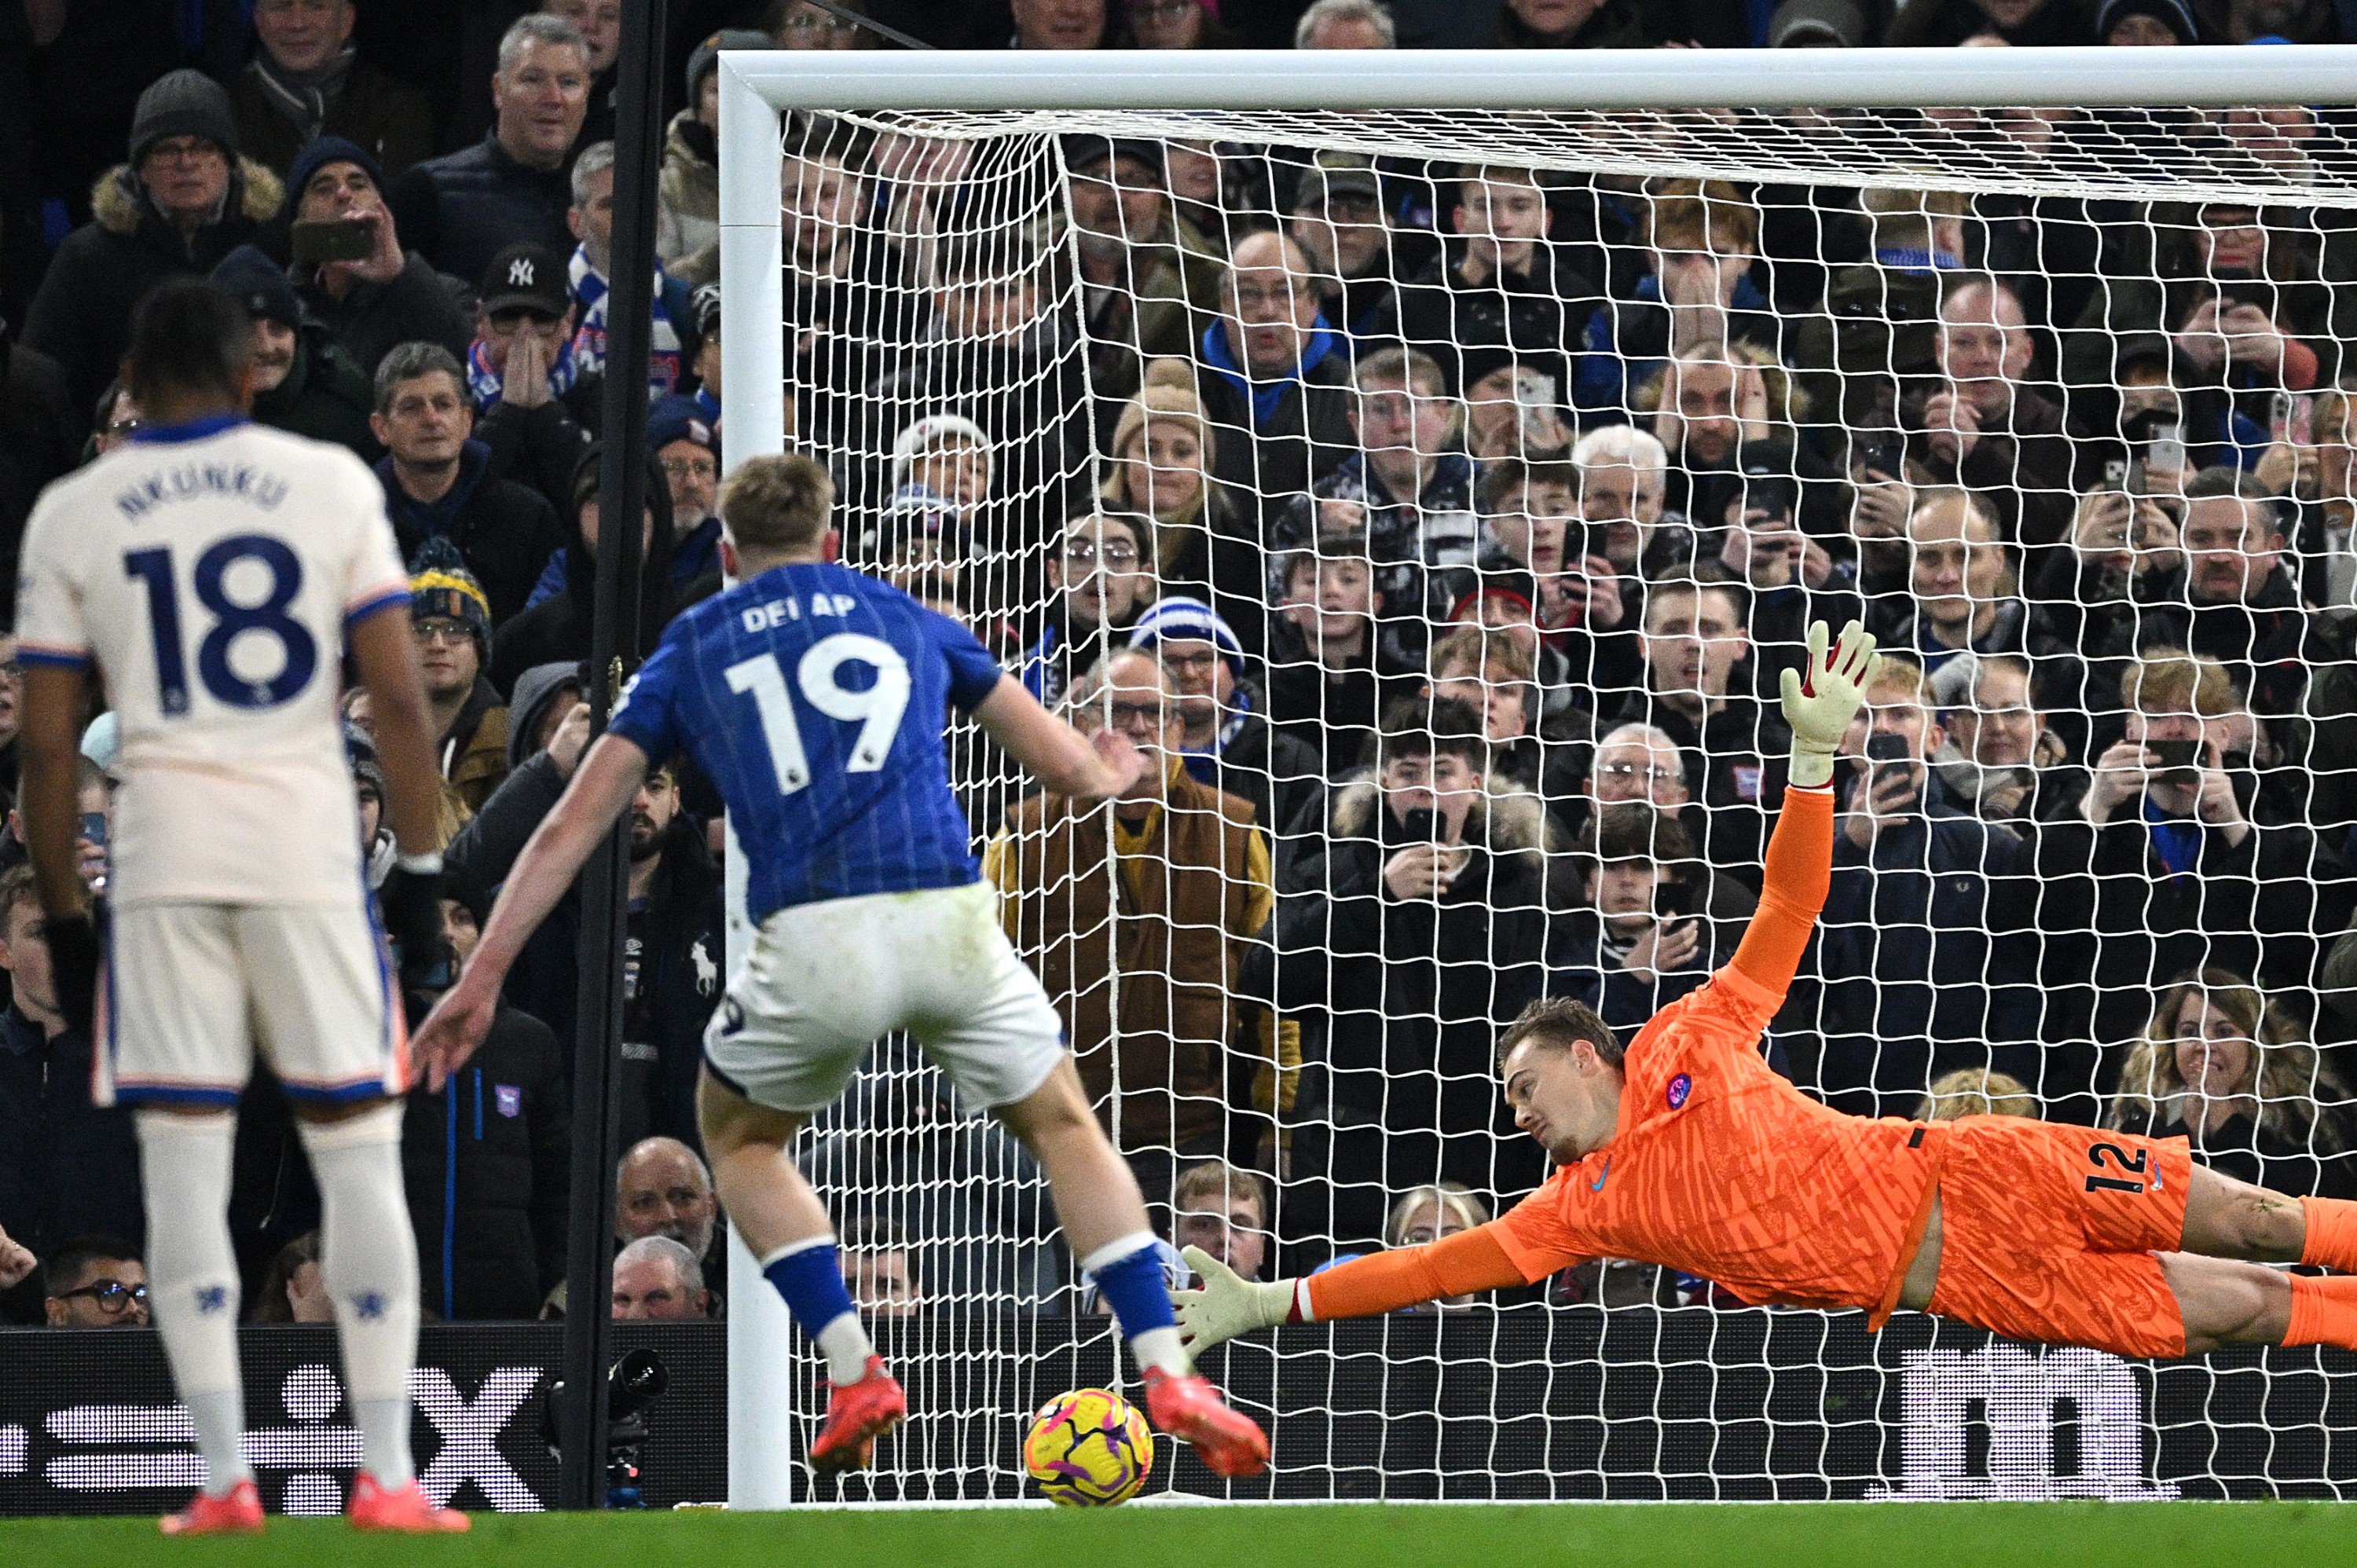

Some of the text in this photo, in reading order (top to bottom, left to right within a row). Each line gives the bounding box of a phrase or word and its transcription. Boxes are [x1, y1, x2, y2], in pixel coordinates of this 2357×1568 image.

[116, 463, 289, 523] NKUNKU
[123, 533, 317, 715] 18
[724, 632, 911, 796] 19
[2085, 1143, 2146, 1193] 12
